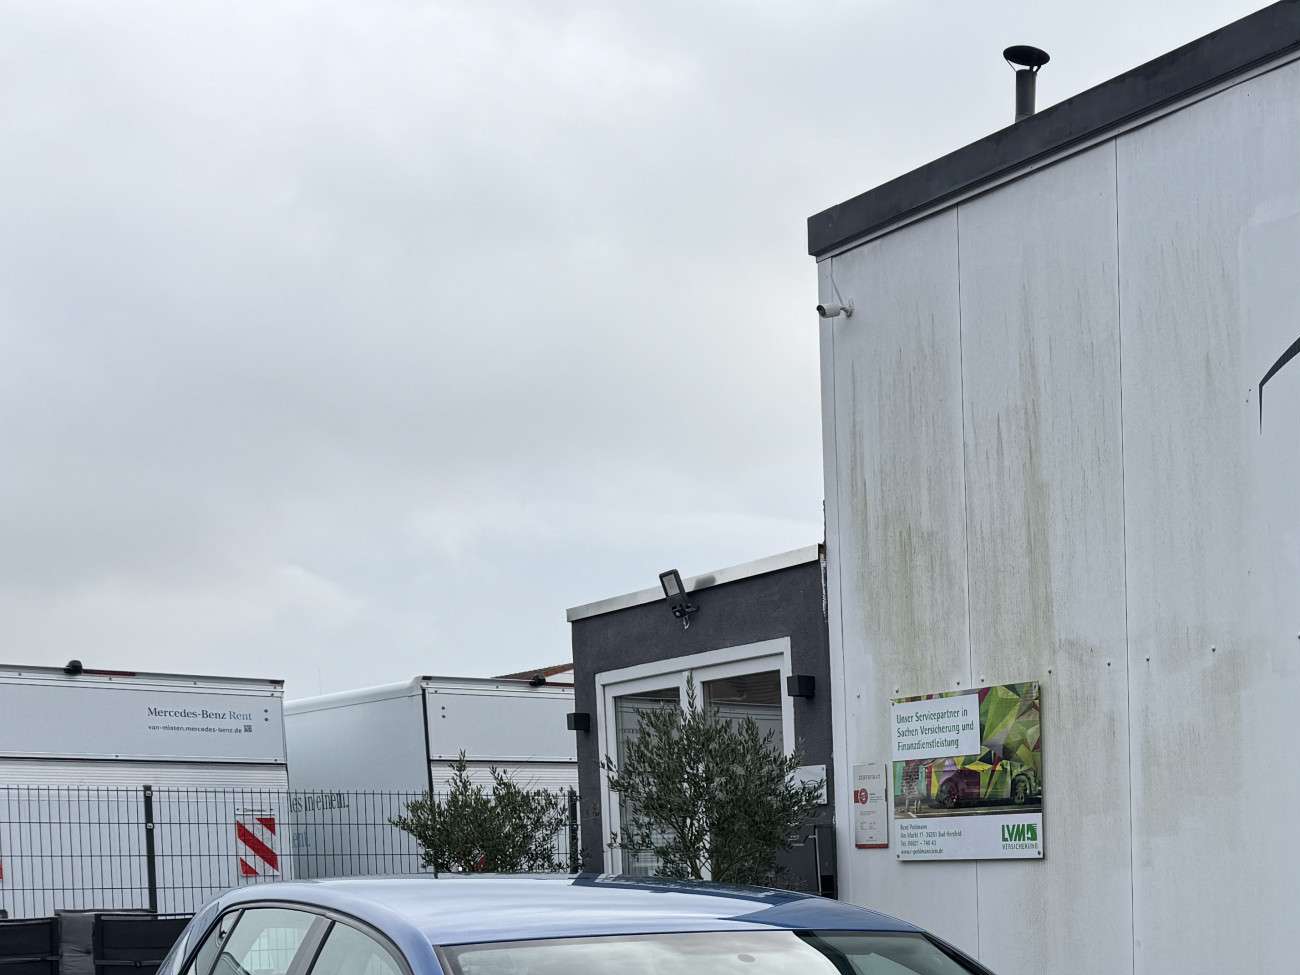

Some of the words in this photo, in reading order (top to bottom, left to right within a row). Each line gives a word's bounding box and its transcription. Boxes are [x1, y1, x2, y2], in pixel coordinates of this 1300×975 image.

[147, 706, 227, 720] Mercedes-Benz
[228, 710, 253, 721] Rent
[896, 714, 913, 724] Unser
[915, 709, 960, 722] Servicepartner
[961, 706, 968, 717] in
[896, 727, 918, 738] Sachen
[920, 723, 960, 735] Versicherung
[961, 720, 974, 731] und
[897, 738, 959, 751] Finanzdienstleistung
